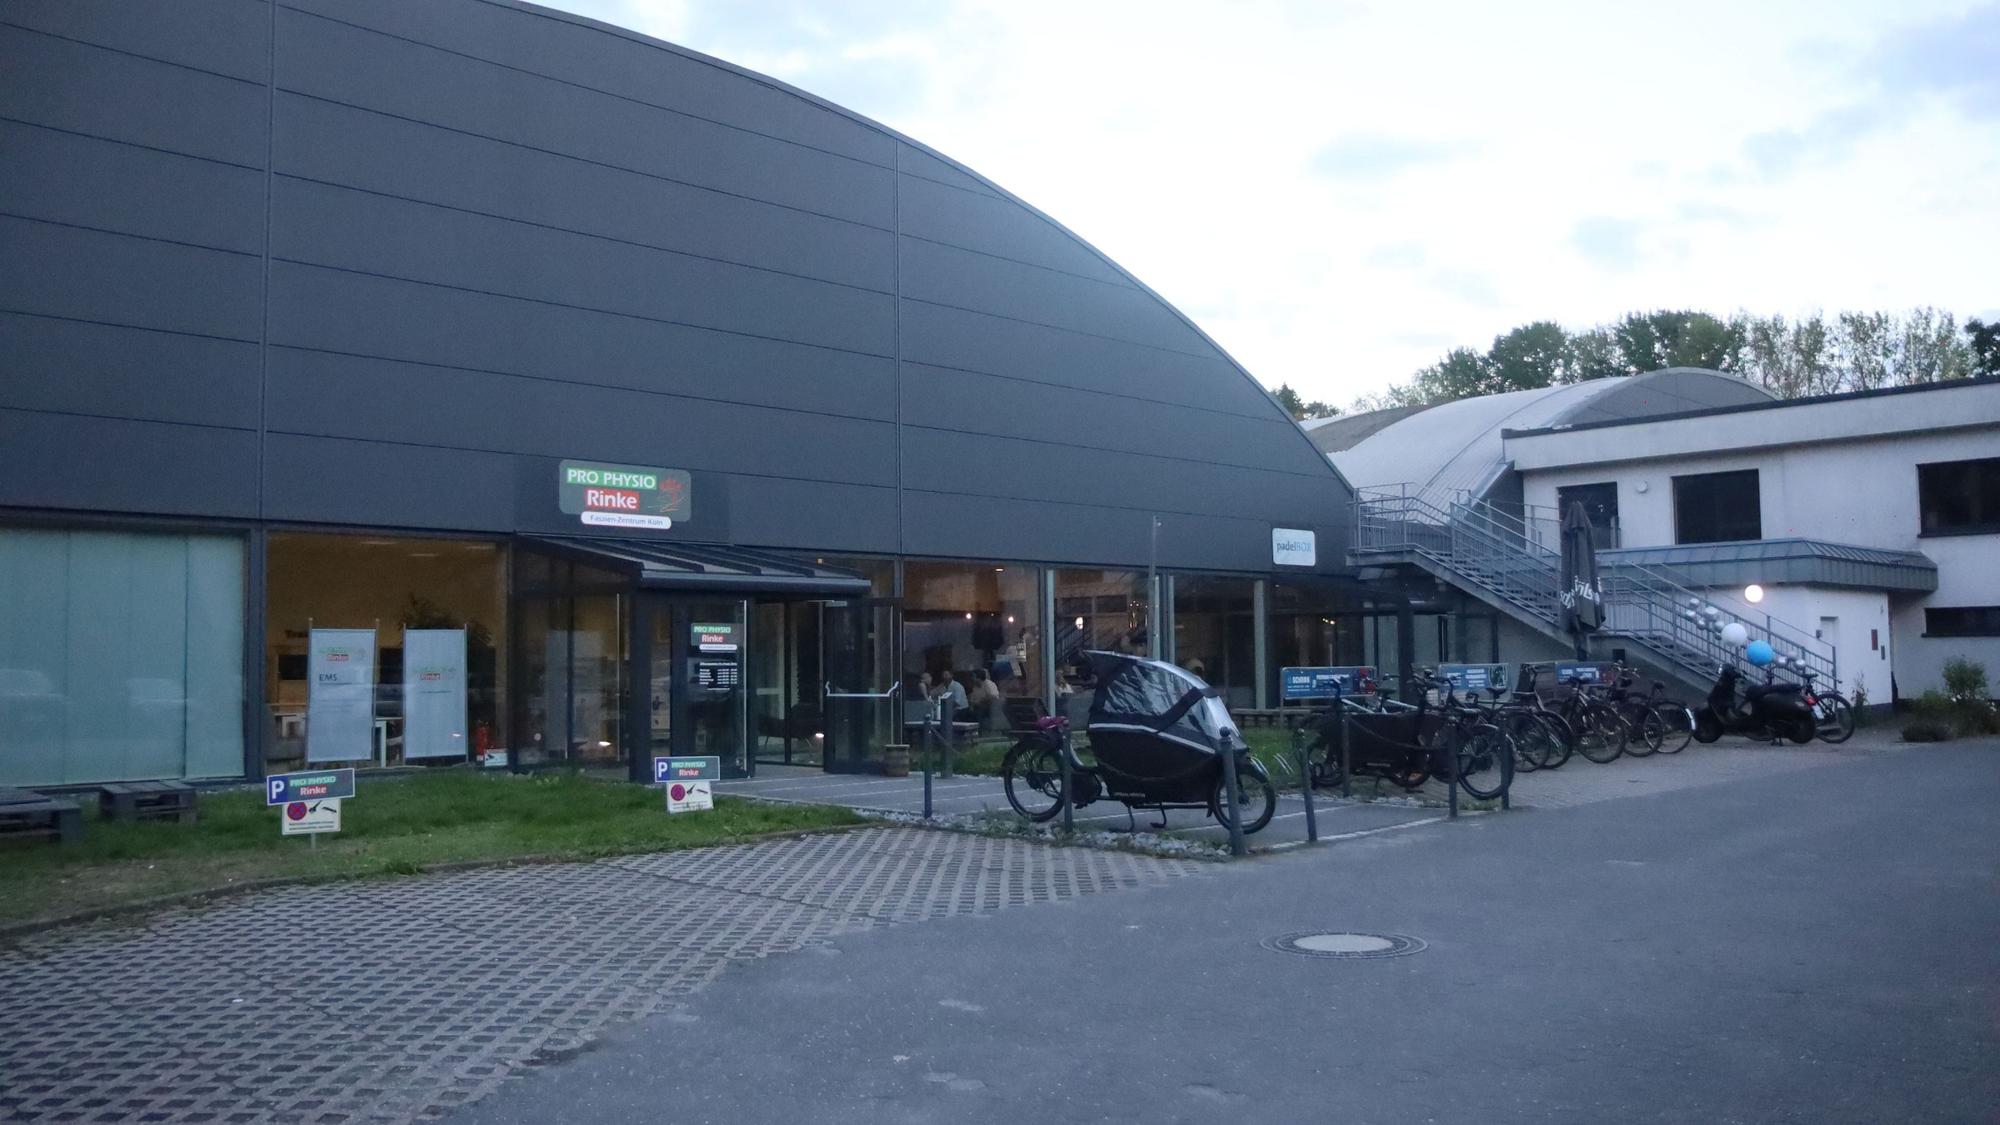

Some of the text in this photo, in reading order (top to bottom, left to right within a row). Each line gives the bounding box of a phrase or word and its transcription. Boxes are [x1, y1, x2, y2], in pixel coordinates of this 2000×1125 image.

[567, 469, 656, 489] PRO PHYSIO
[587, 490, 637, 509] Rinke
[701, 634, 723, 643] Rinke
[319, 673, 337, 681] EMS
[658, 761, 668, 778] P
[290, 776, 336, 787] PRO PHYSIO
[271, 780, 285, 799] P
[300, 786, 327, 796] Rinke
